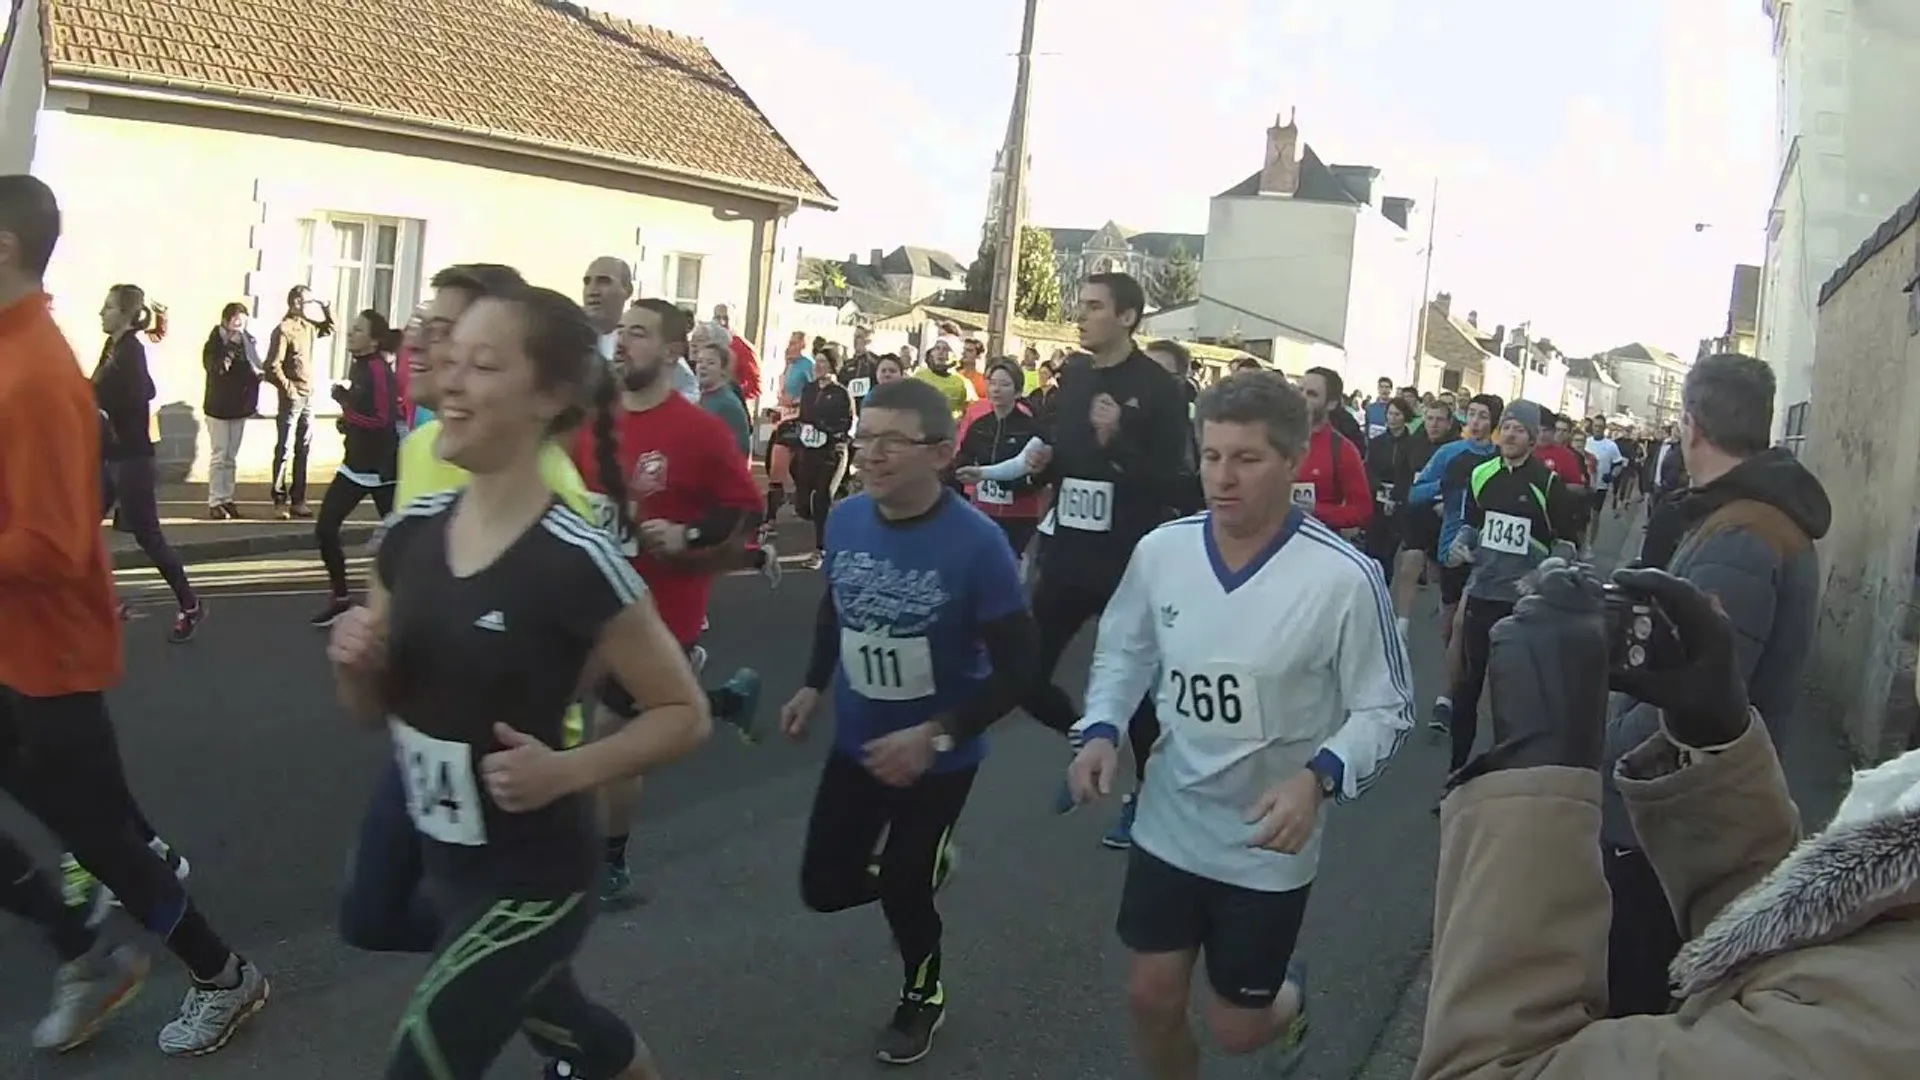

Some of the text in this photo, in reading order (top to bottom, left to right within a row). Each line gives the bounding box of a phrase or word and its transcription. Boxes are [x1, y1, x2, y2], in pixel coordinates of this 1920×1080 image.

[1062, 487, 1106, 521] 1600
[1487, 519, 1526, 547] 1343
[858, 645, 902, 688] 111
[1170, 669, 1242, 724] 266
